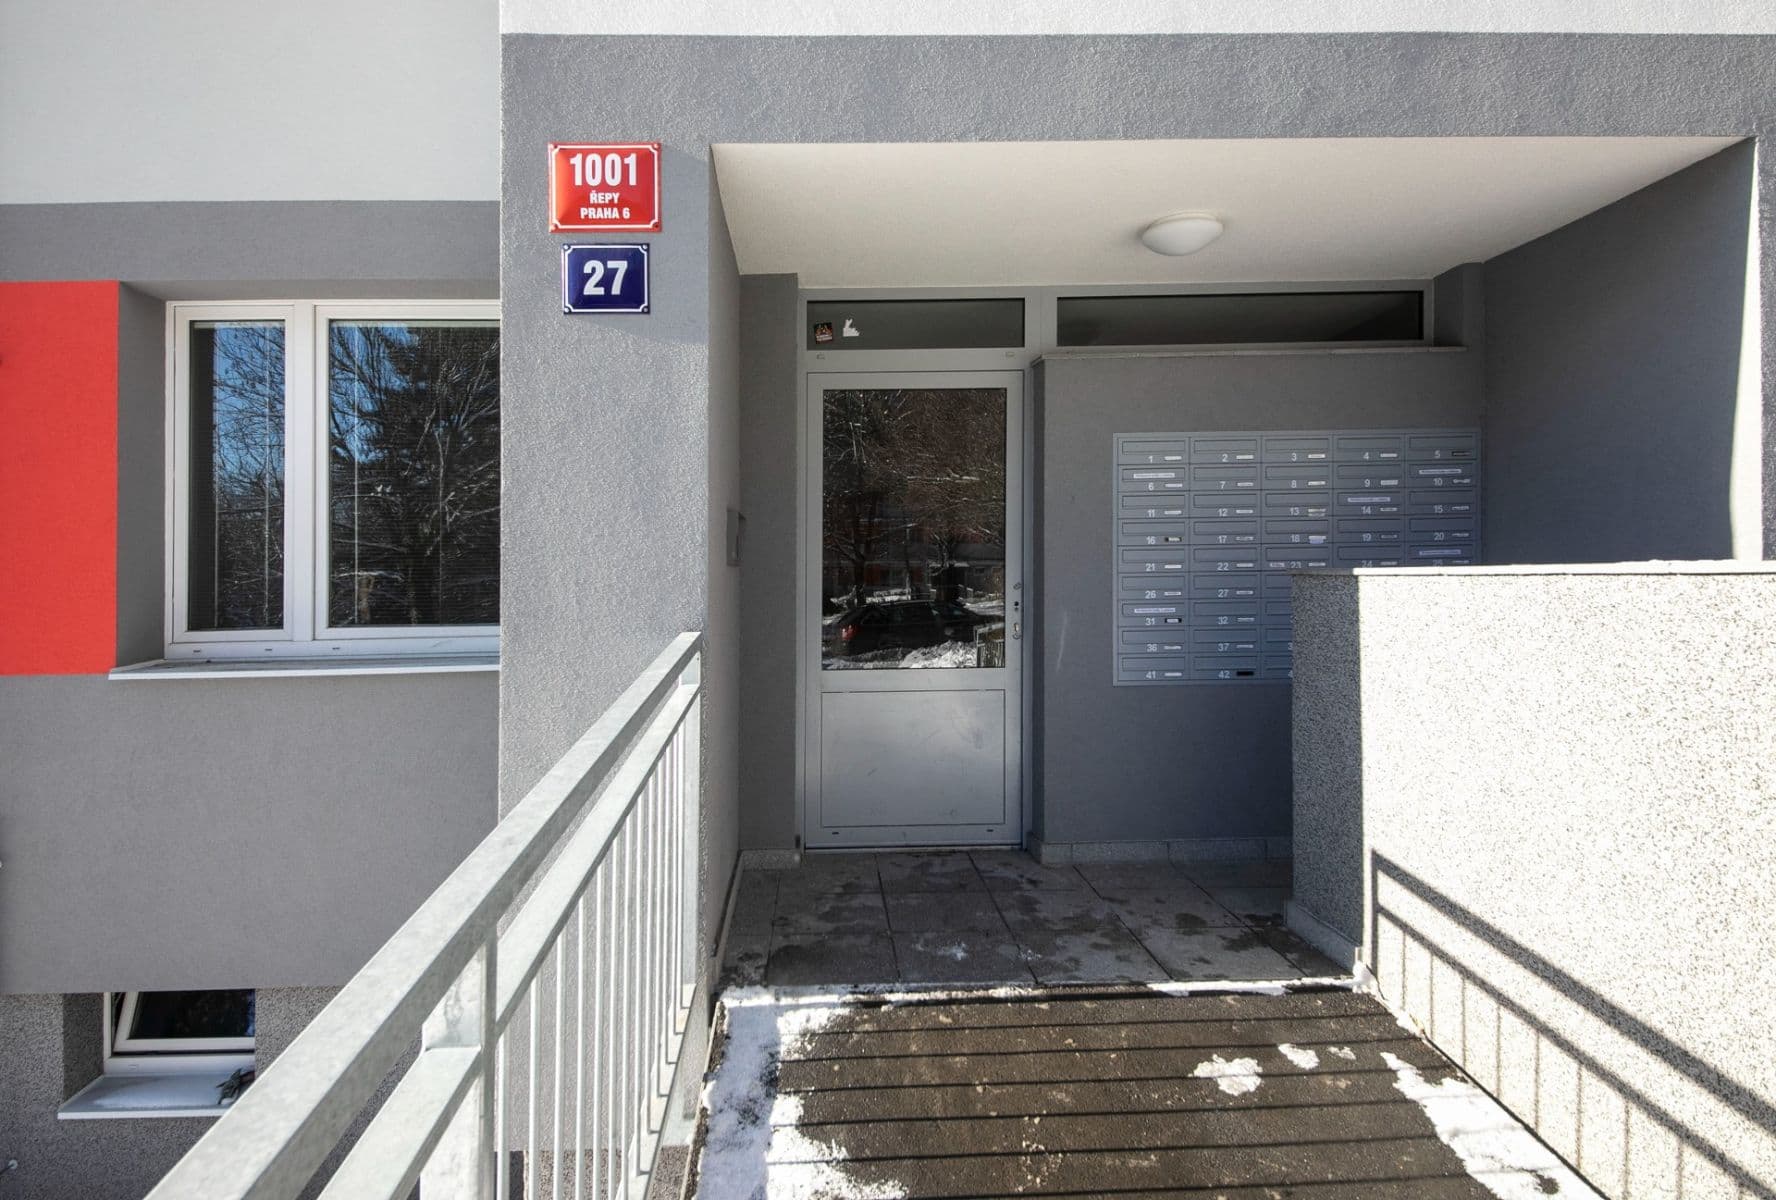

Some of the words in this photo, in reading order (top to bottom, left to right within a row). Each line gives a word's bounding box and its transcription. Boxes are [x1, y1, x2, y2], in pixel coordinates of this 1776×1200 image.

[570, 153, 637, 186] 1001
[590, 191, 620, 203] ŘEPY
[581, 208, 619, 219] PRAHA
[623, 208, 630, 219] 6
[584, 260, 628, 295] 27
